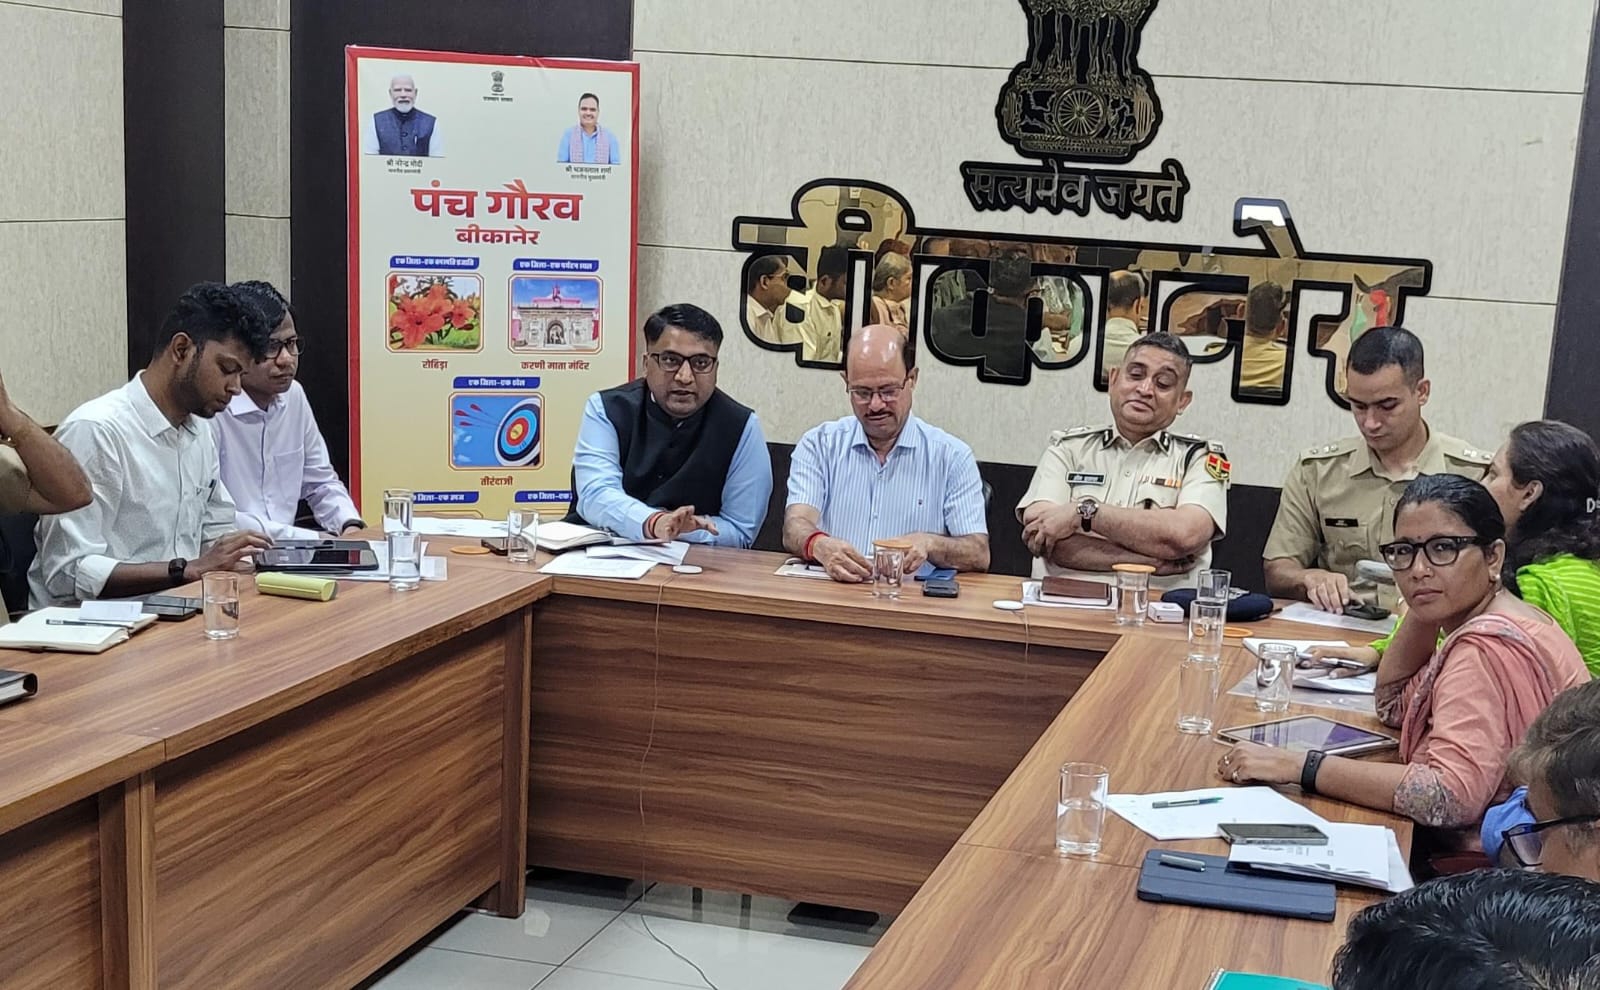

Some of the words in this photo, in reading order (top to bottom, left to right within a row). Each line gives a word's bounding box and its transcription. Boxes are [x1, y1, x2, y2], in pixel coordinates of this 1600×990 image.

[963, 158, 1091, 212] सत्यमेव
[1093, 163, 1187, 218] जयते
[410, 179, 478, 218] पंच
[486, 179, 583, 221] गौरव
[455, 223, 540, 245] बीकानेर
[733, 179, 1432, 411] बीकानेर
[422, 359, 448, 371] रोहिड़ा
[521, 360, 545, 370] करणी
[546, 361, 567, 370] माता
[568, 361, 590, 371] मंदिर
[480, 475, 513, 486] तीरंदाजी
